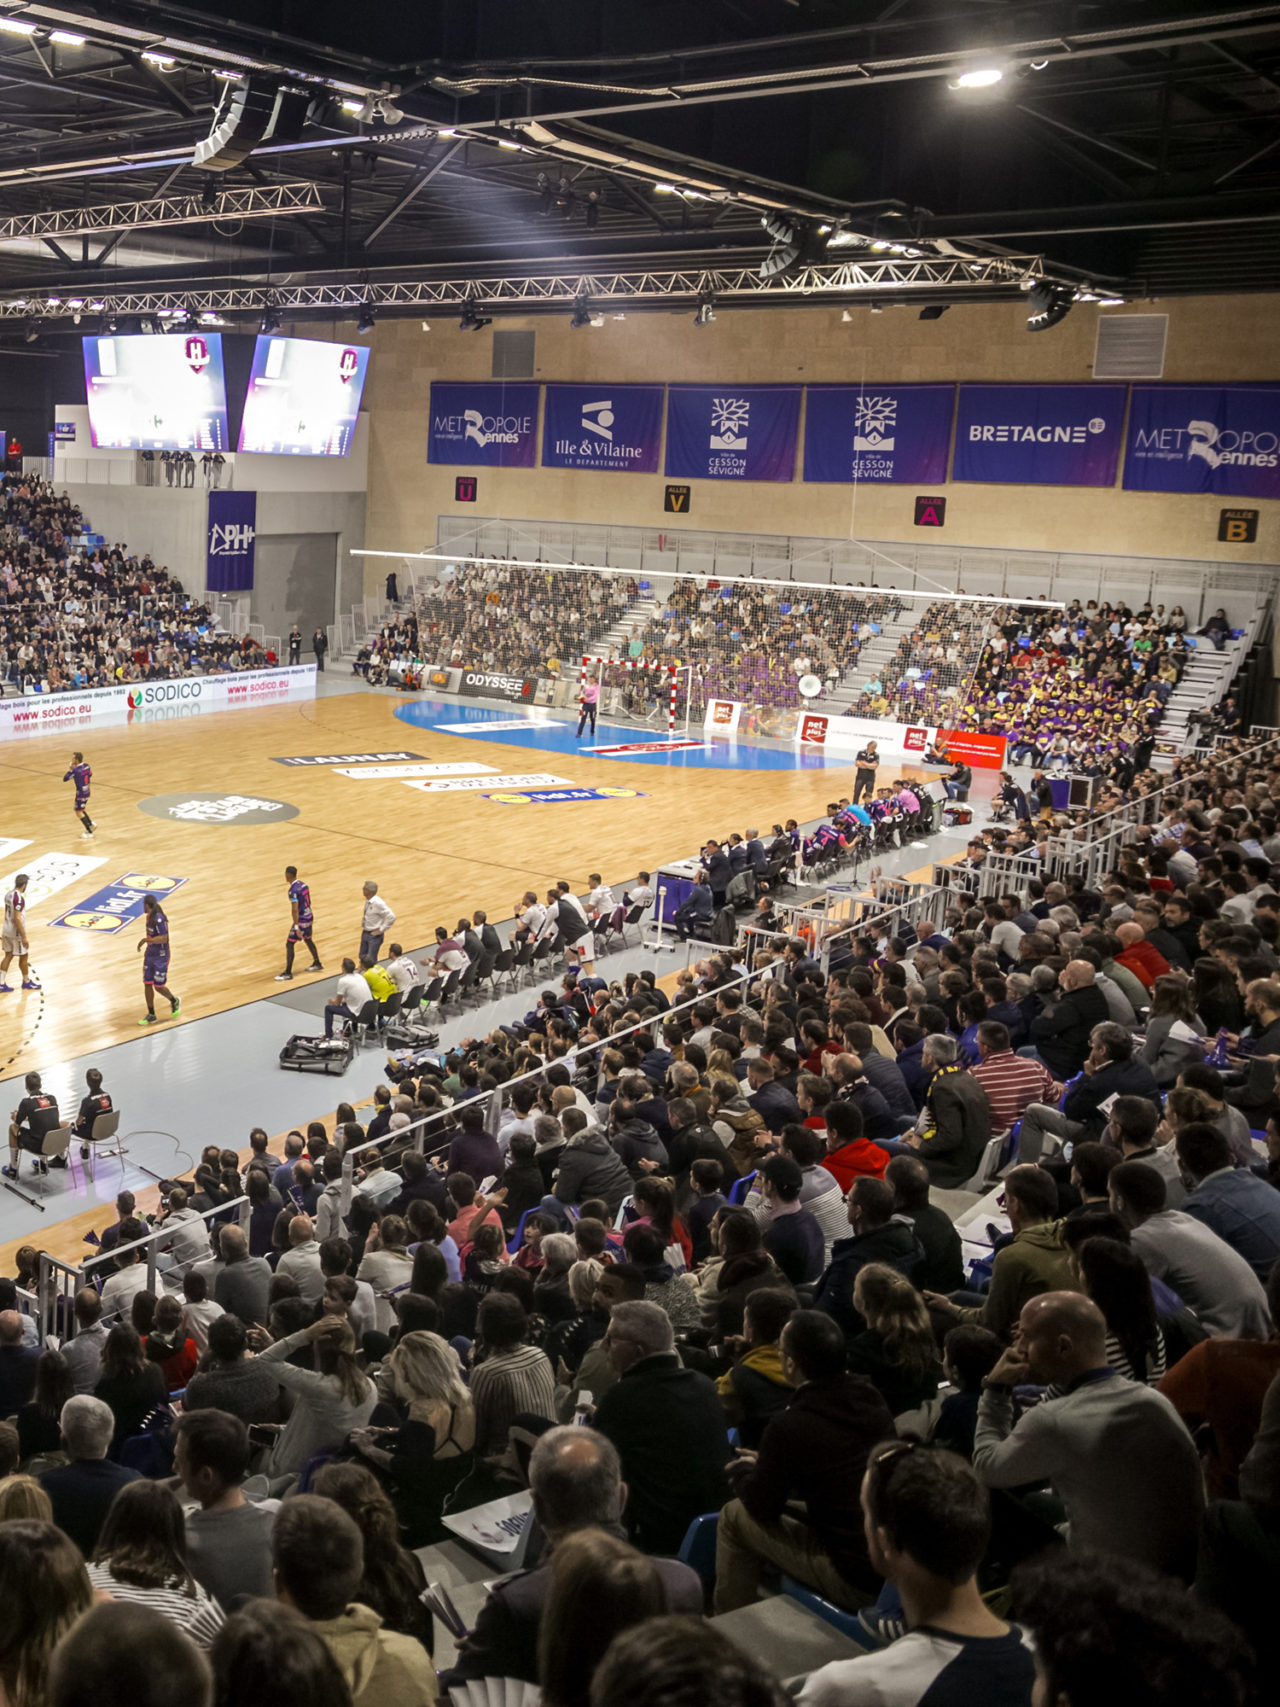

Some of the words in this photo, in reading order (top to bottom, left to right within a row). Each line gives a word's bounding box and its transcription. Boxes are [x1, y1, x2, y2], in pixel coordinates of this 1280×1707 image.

[970, 425, 1086, 442] BRETAGNE
[556, 440, 576, 454] Ille
[580, 439, 592, 455] &
[594, 442, 642, 458] Vilaine
[708, 458, 746, 467] CESSON
[708, 465, 745, 476] SÉVIGNÉ
[852, 460, 894, 469] CESSON
[852, 468, 892, 478] SÉVIGNÉ
[460, 485, 472, 501] U
[671, 495, 684, 512] V
[920, 506, 939, 525] A
[1227, 520, 1248, 541] B
[227, 679, 289, 694] www.sodico.eu
[466, 674, 523, 691] ODYSSEE
[145, 682, 201, 703] SODICO
[13, 704, 91, 722] www.sodico.eu
[808, 720, 822, 728] net
[806, 729, 821, 737] plus
[908, 738, 922, 746] plus
[94, 889, 147, 913] lidl.fr
